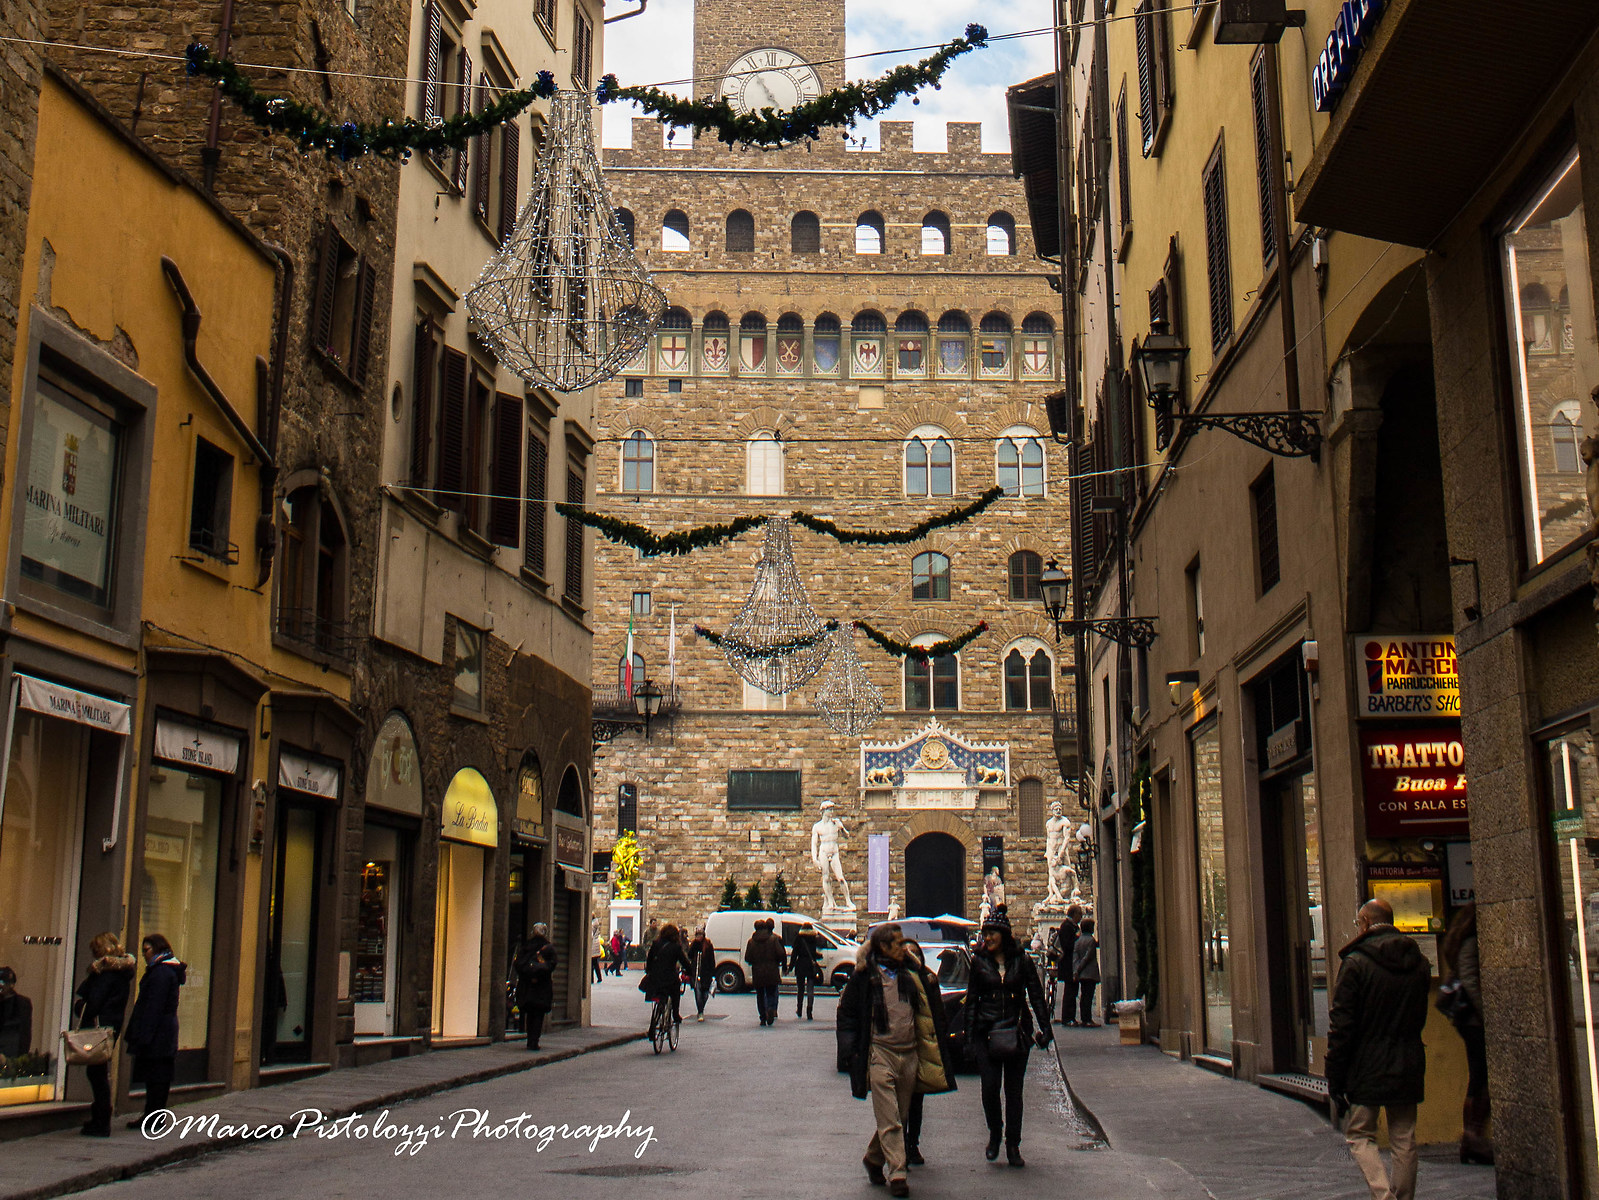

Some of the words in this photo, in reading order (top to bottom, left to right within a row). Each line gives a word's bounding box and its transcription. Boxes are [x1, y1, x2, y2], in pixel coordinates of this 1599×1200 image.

[764, 52, 778, 67] XII
[26, 485, 61, 517] MARINA
[63, 502, 105, 537] MILITARE
[49, 696, 76, 715] MARINA
[81, 704, 112, 725] MILITARE
[1368, 695, 1433, 713] BARBER'S
[182, 747, 197, 762] STONE
[198, 750, 213, 766] ISLAND
[1367, 741, 1465, 769] TRATTO
[1393, 775, 1448, 792] Buca
[452, 801, 465, 828] La
[1379, 802, 1408, 812] CON
[1414, 800, 1447, 811] SALA
[1369, 867, 1405, 876] TRATTORIA
